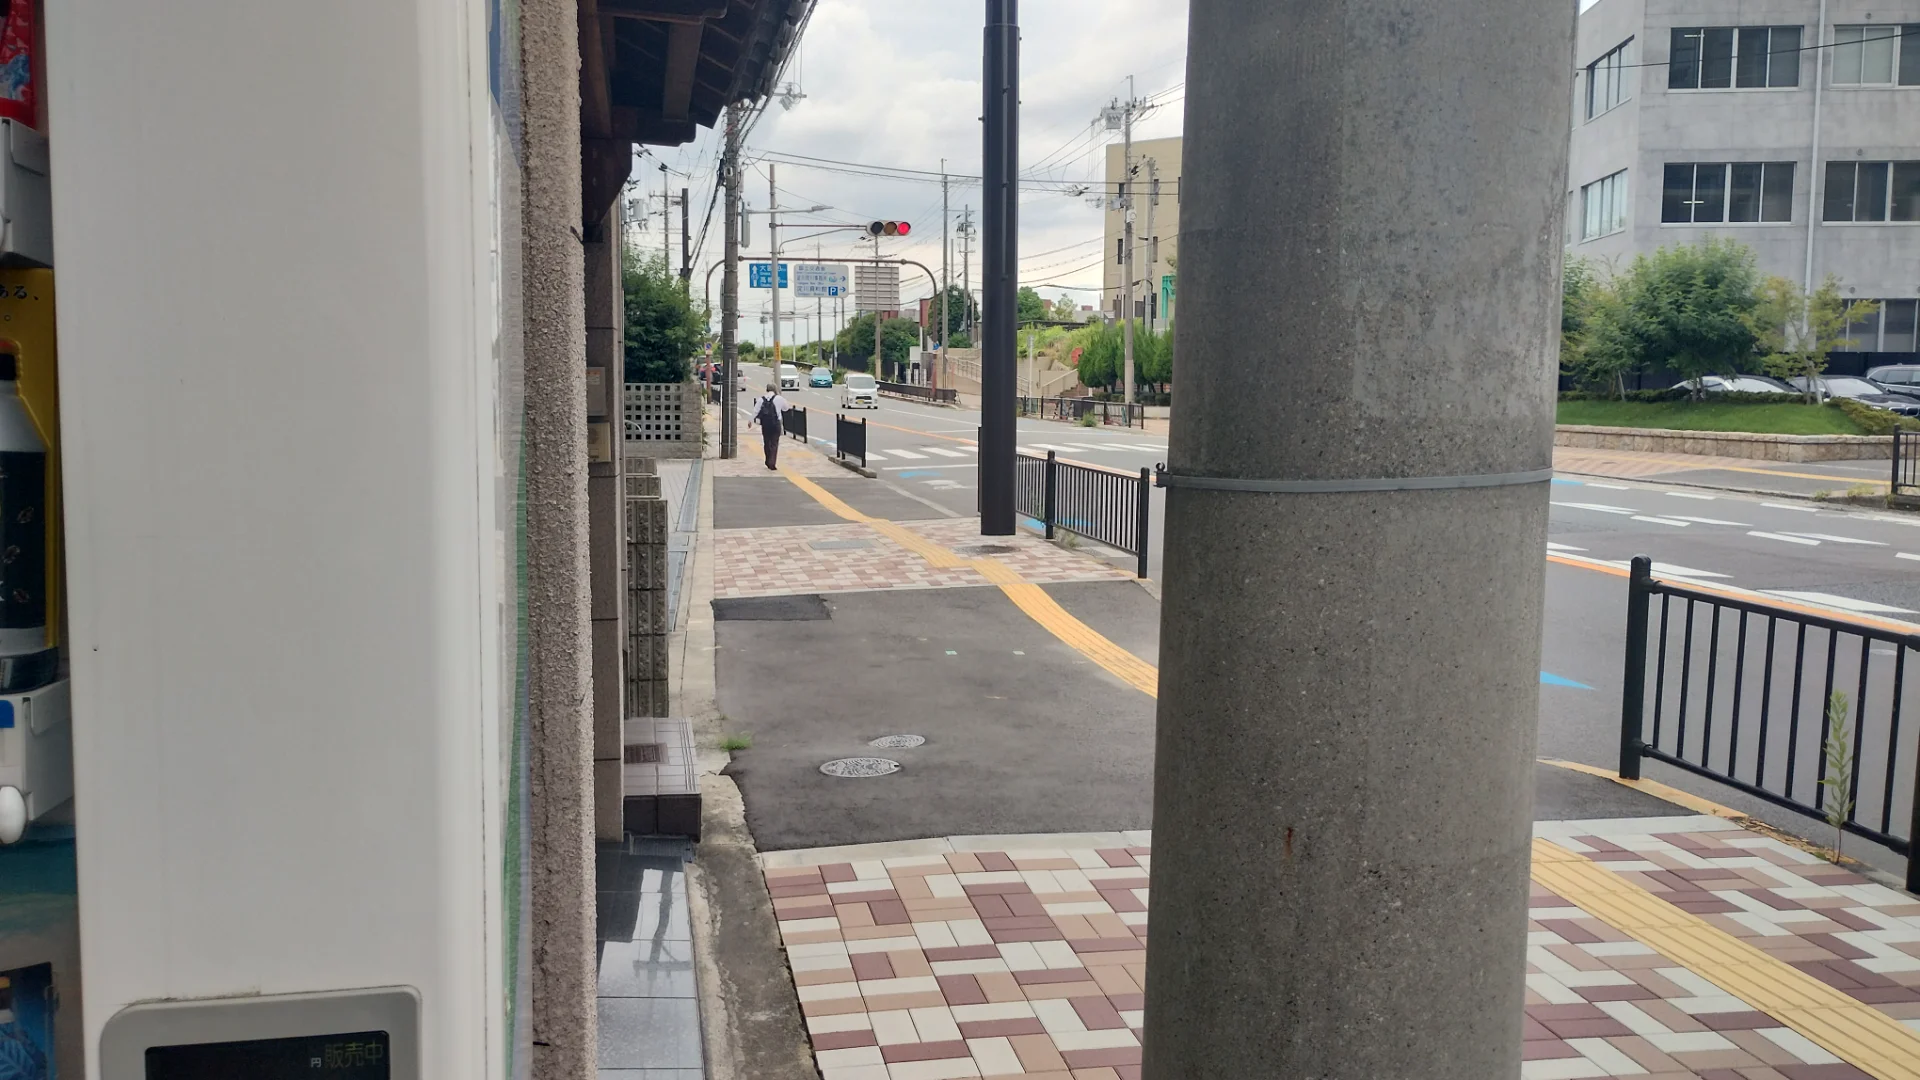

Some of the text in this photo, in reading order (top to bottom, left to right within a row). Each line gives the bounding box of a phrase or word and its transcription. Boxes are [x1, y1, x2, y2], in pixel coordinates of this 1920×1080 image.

[310, 1039, 383, 1069] 円 販売中
